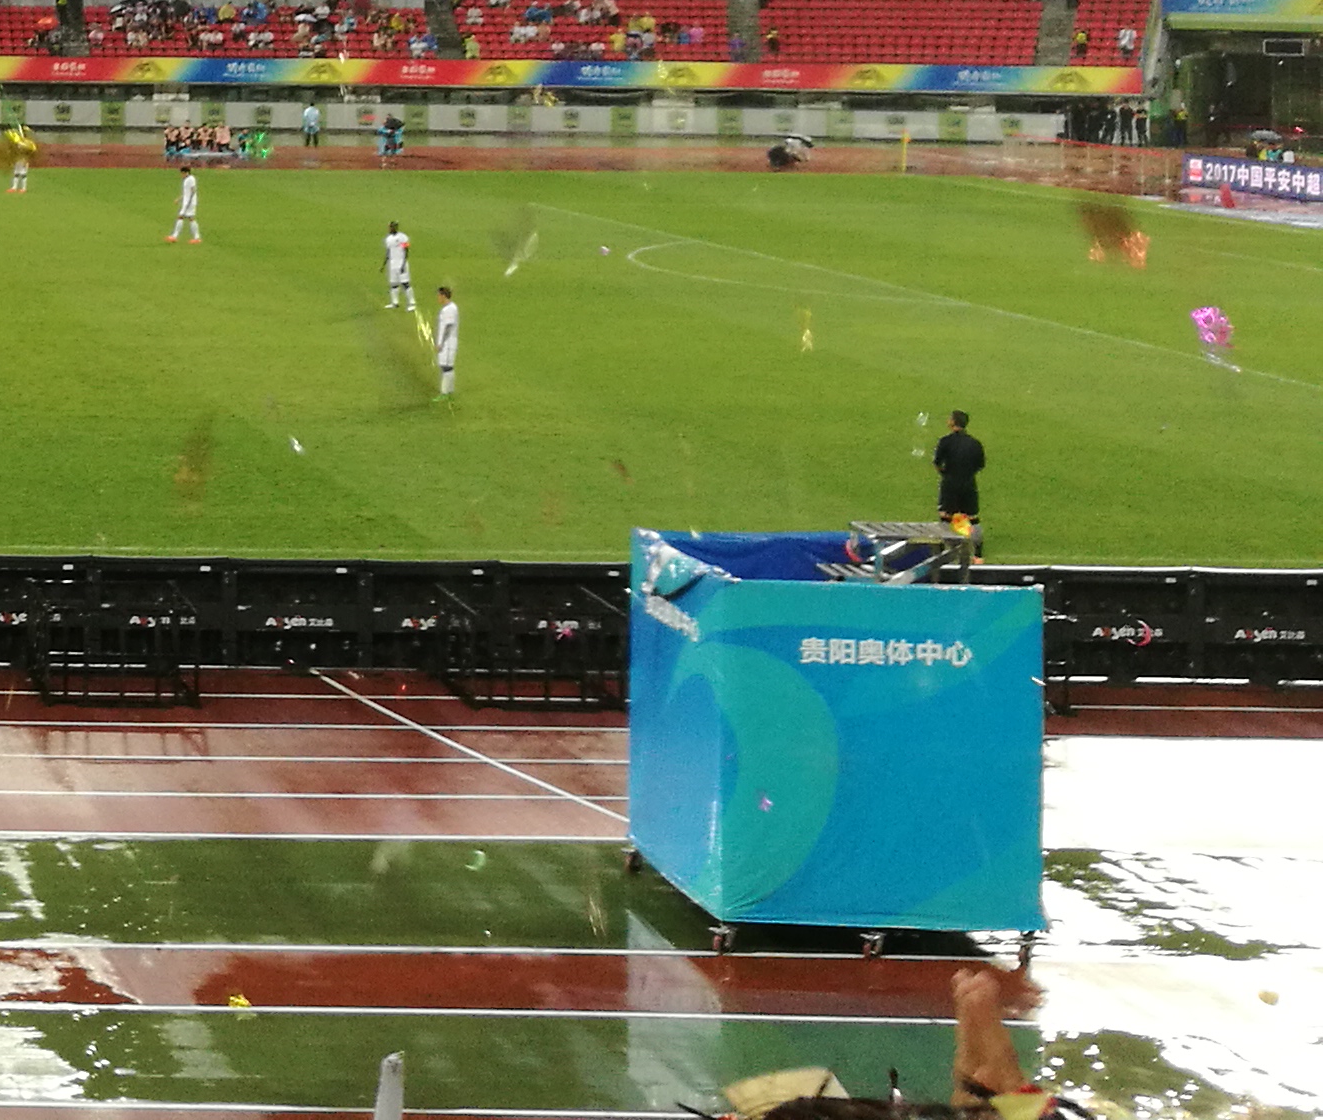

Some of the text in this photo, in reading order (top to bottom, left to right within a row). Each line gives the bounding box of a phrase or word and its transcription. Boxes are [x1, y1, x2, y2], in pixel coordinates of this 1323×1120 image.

[799, 636, 973, 667] 贵阳奥体中心
